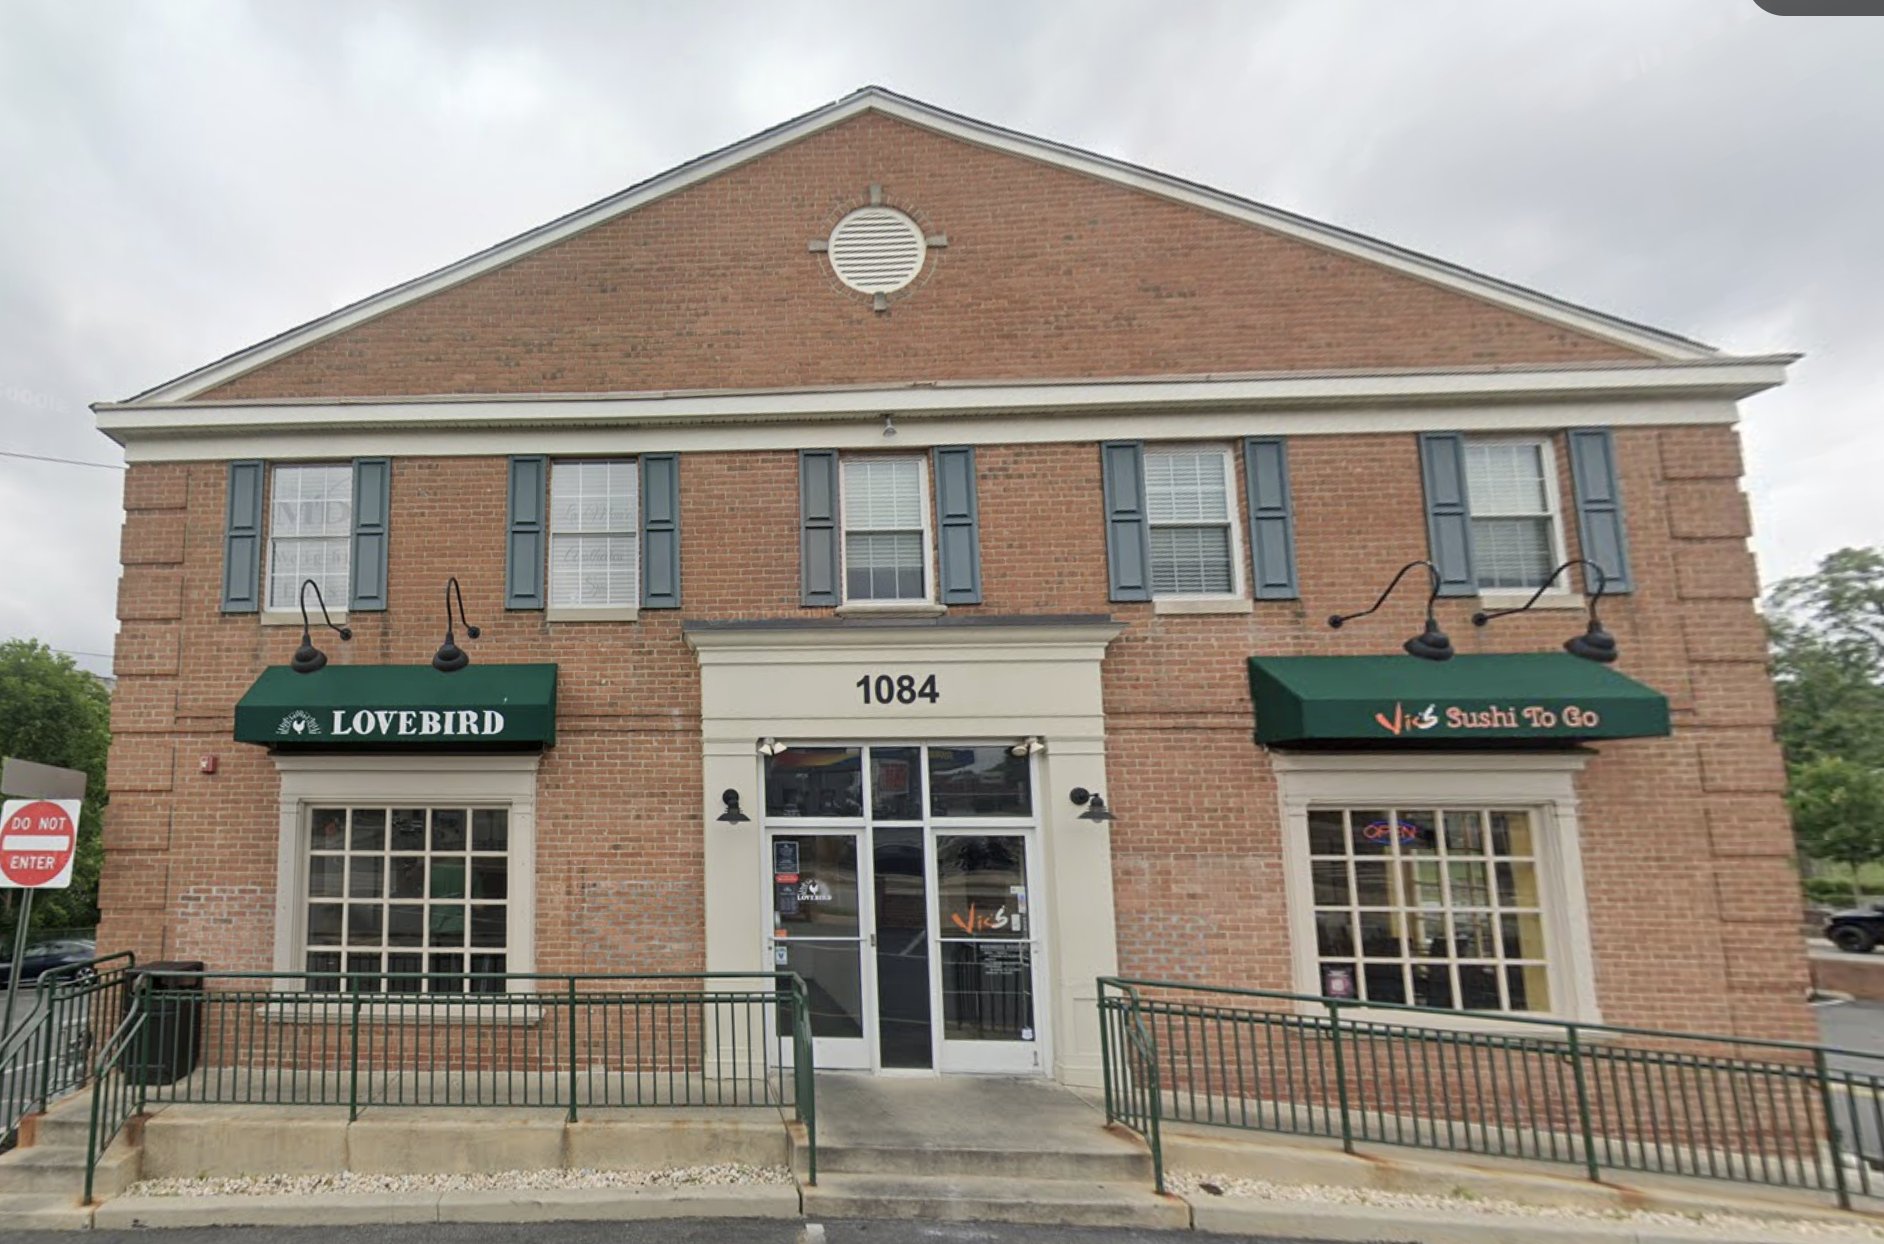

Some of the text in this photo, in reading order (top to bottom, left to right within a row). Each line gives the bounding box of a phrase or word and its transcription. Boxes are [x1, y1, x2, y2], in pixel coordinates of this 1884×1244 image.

[857, 675, 940, 704] 1084
[331, 710, 504, 735] LOVEBIRD
[1446, 705, 1519, 728] Sushi
[1521, 706, 1557, 727] To
[1562, 706, 1599, 728] Go
[11, 817, 66, 830] DO NOT
[10, 856, 56, 869] ENTER
